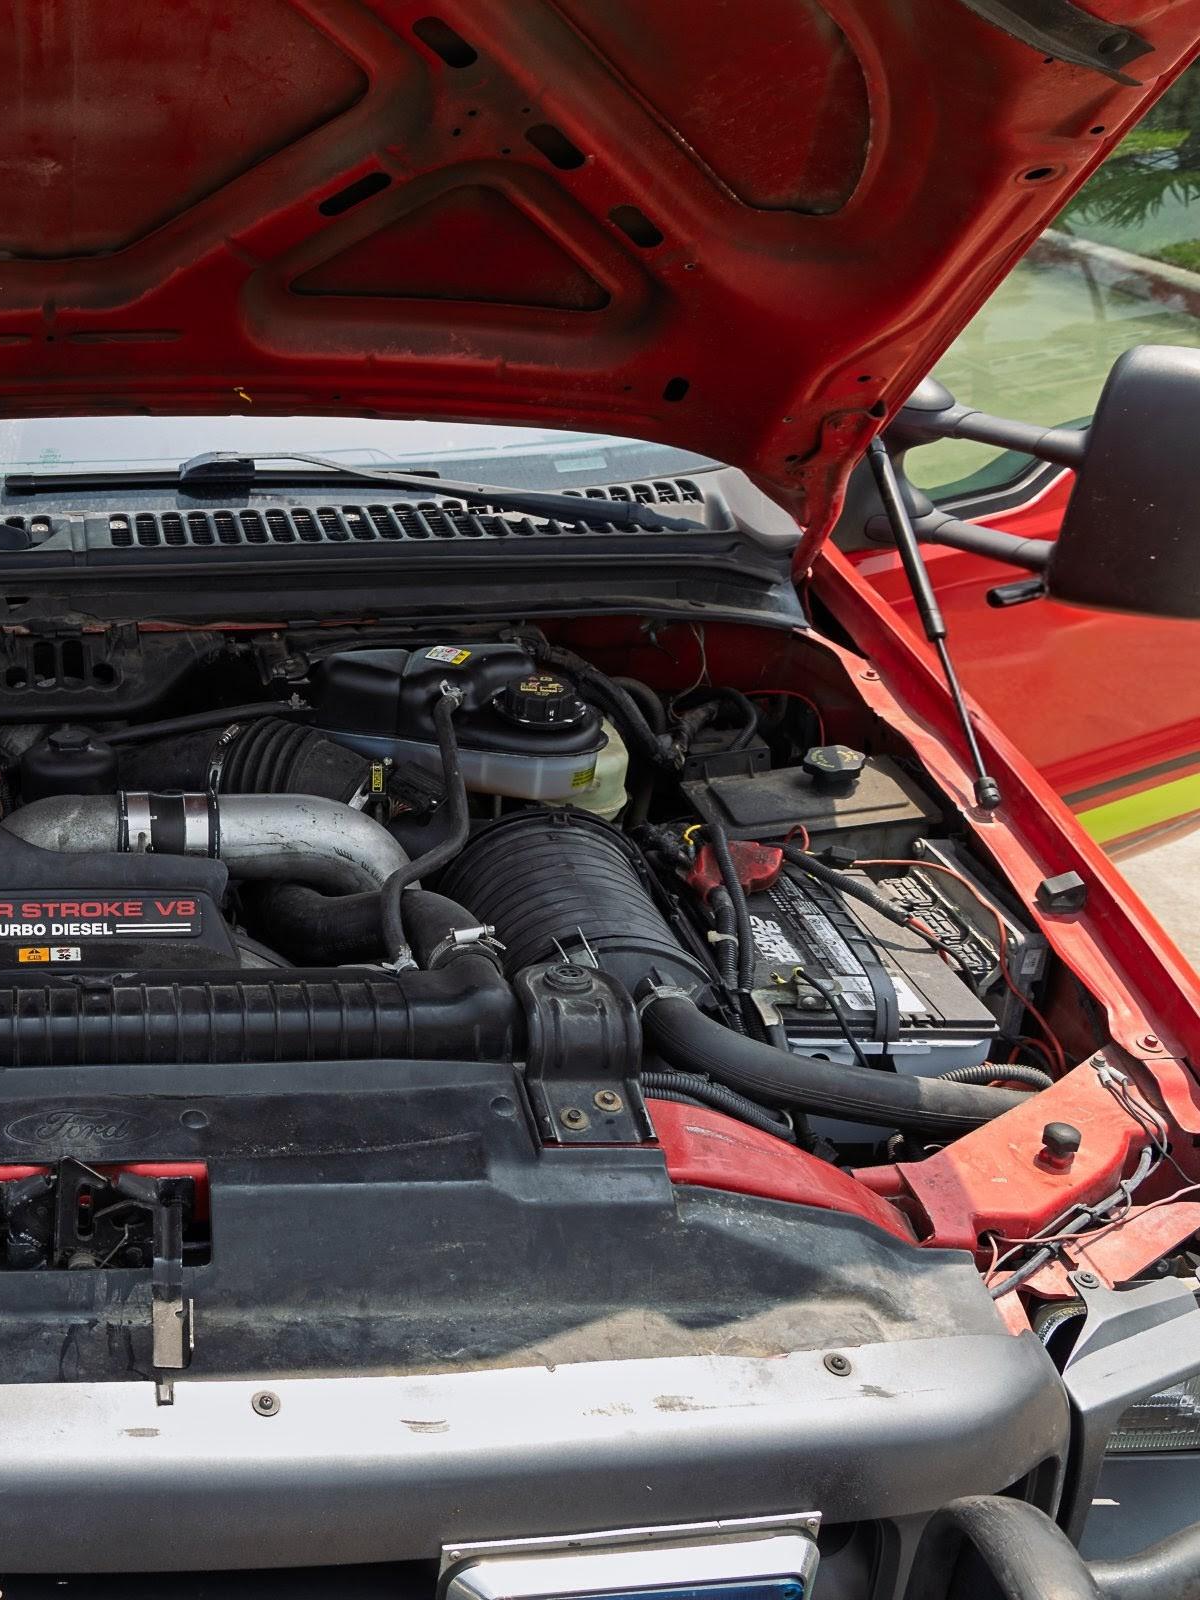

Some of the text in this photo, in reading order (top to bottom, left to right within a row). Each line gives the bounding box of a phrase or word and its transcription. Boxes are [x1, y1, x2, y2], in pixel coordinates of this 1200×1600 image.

[21, 901, 143, 918] STROKE
[154, 900, 197, 917] V8
[51, 922, 113, 936] DIESEL
[765, 920, 801, 963] SUPER
[36, 1111, 130, 1140] Ford
